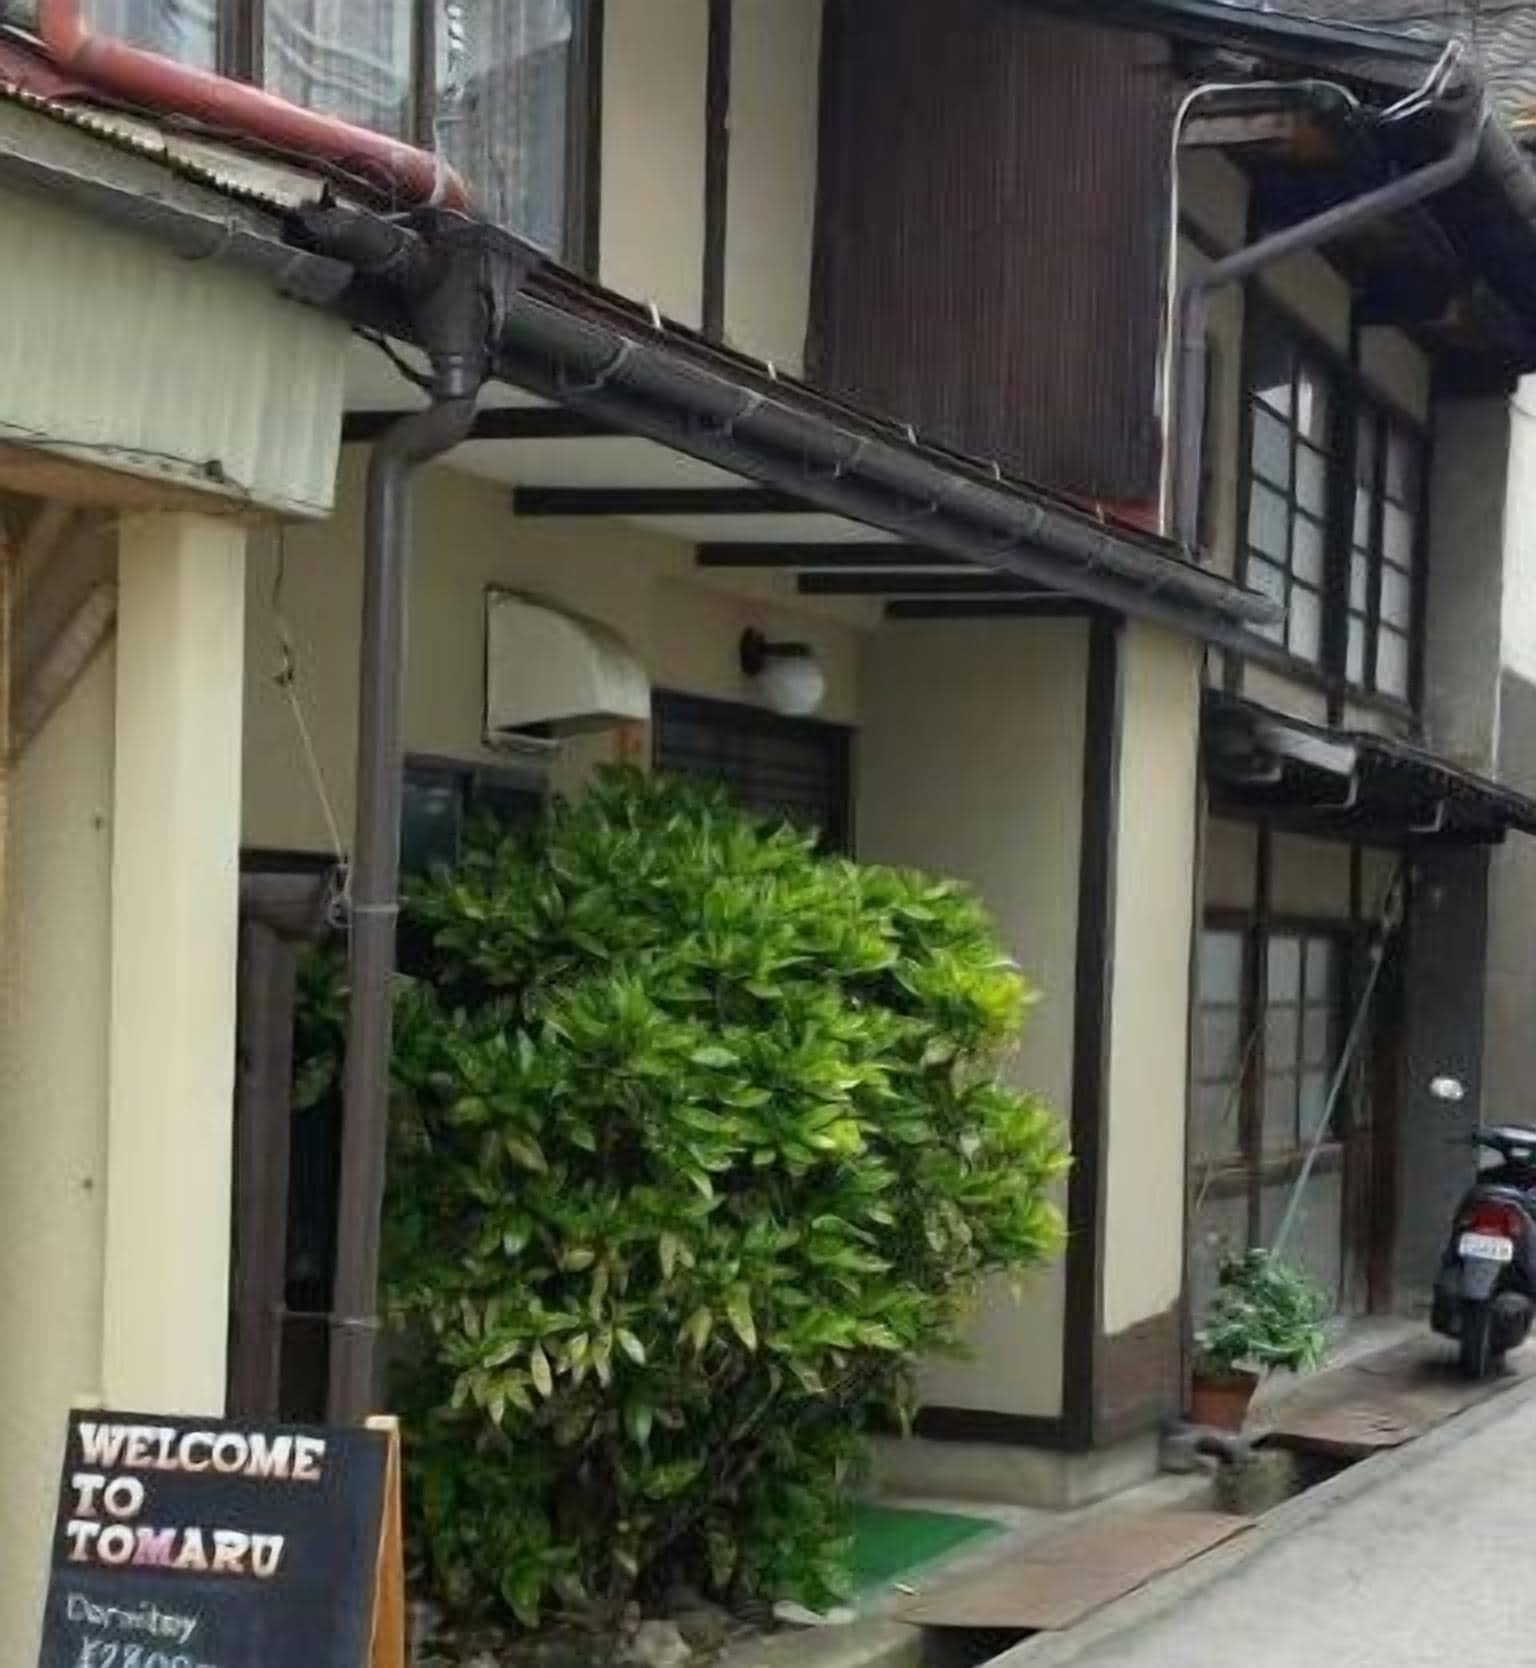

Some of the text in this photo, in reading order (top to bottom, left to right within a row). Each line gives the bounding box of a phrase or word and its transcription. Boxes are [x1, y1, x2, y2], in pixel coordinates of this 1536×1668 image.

[79, 1422, 326, 1480] WELCOME
[71, 1472, 144, 1517] TO
[66, 1520, 284, 1577] TOMARU
